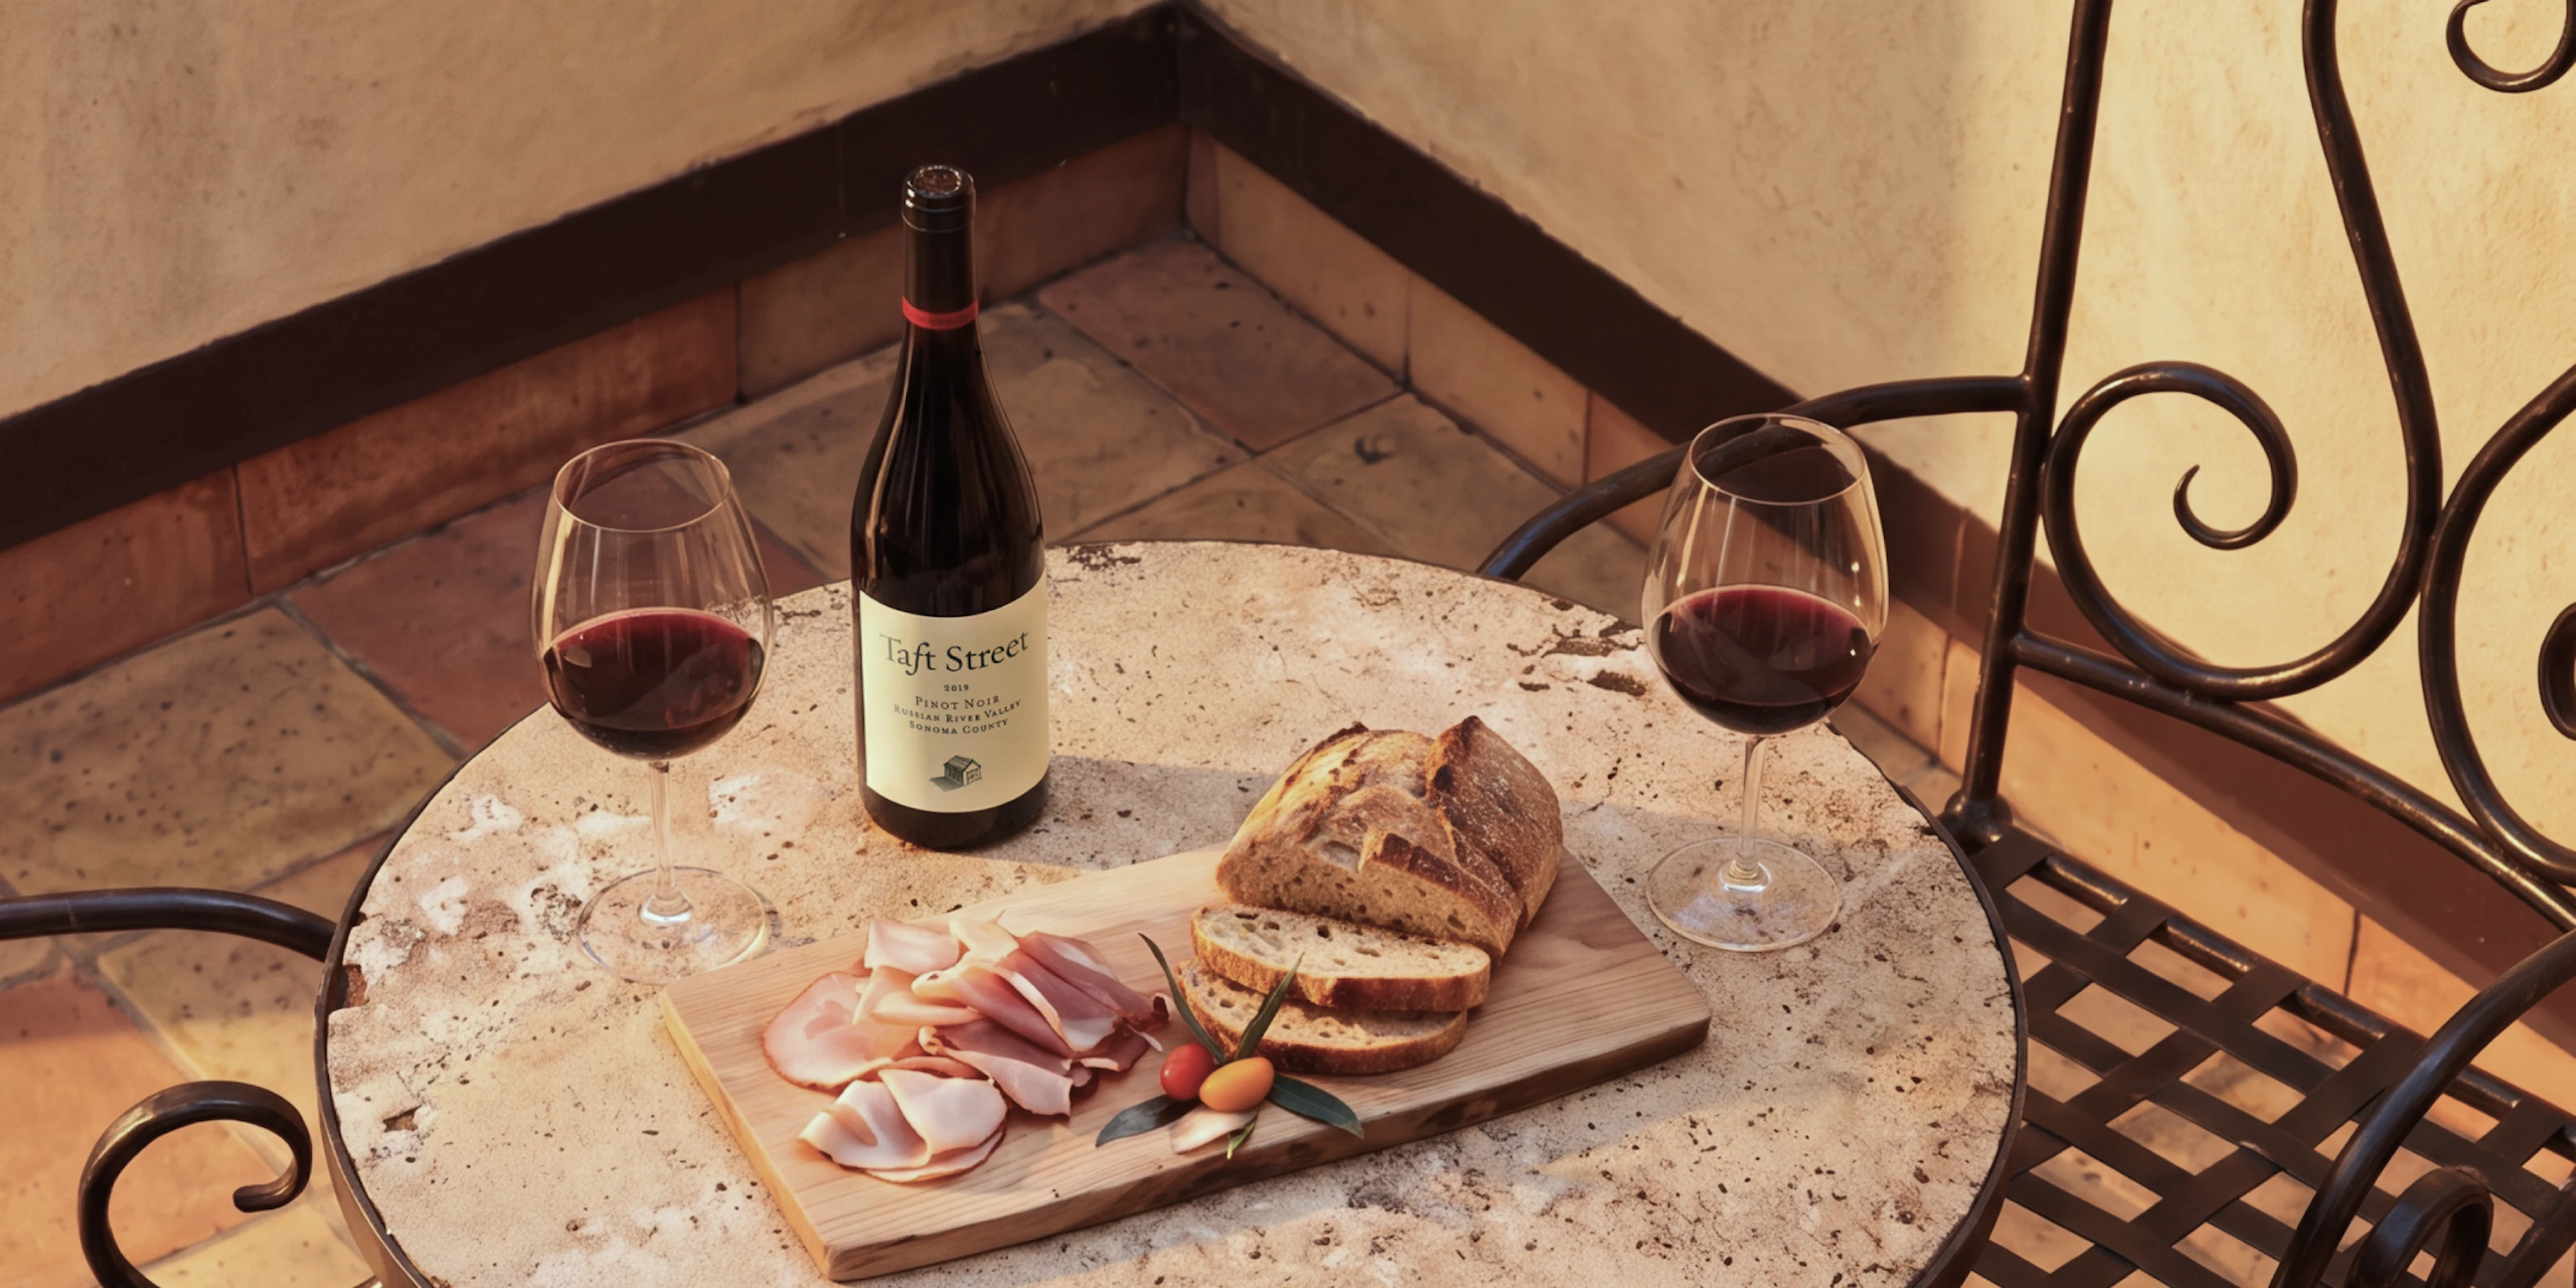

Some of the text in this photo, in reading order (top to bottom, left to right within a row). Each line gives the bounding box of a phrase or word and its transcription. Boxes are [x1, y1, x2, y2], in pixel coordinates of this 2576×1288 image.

[879, 631, 1029, 676] Taft Street
[894, 700, 1021, 722] RUSSIAN RIVER VALLEY
[915, 695, 1000, 710] PINOT NOIR
[909, 718, 1008, 735] SONOMA COUNTY
